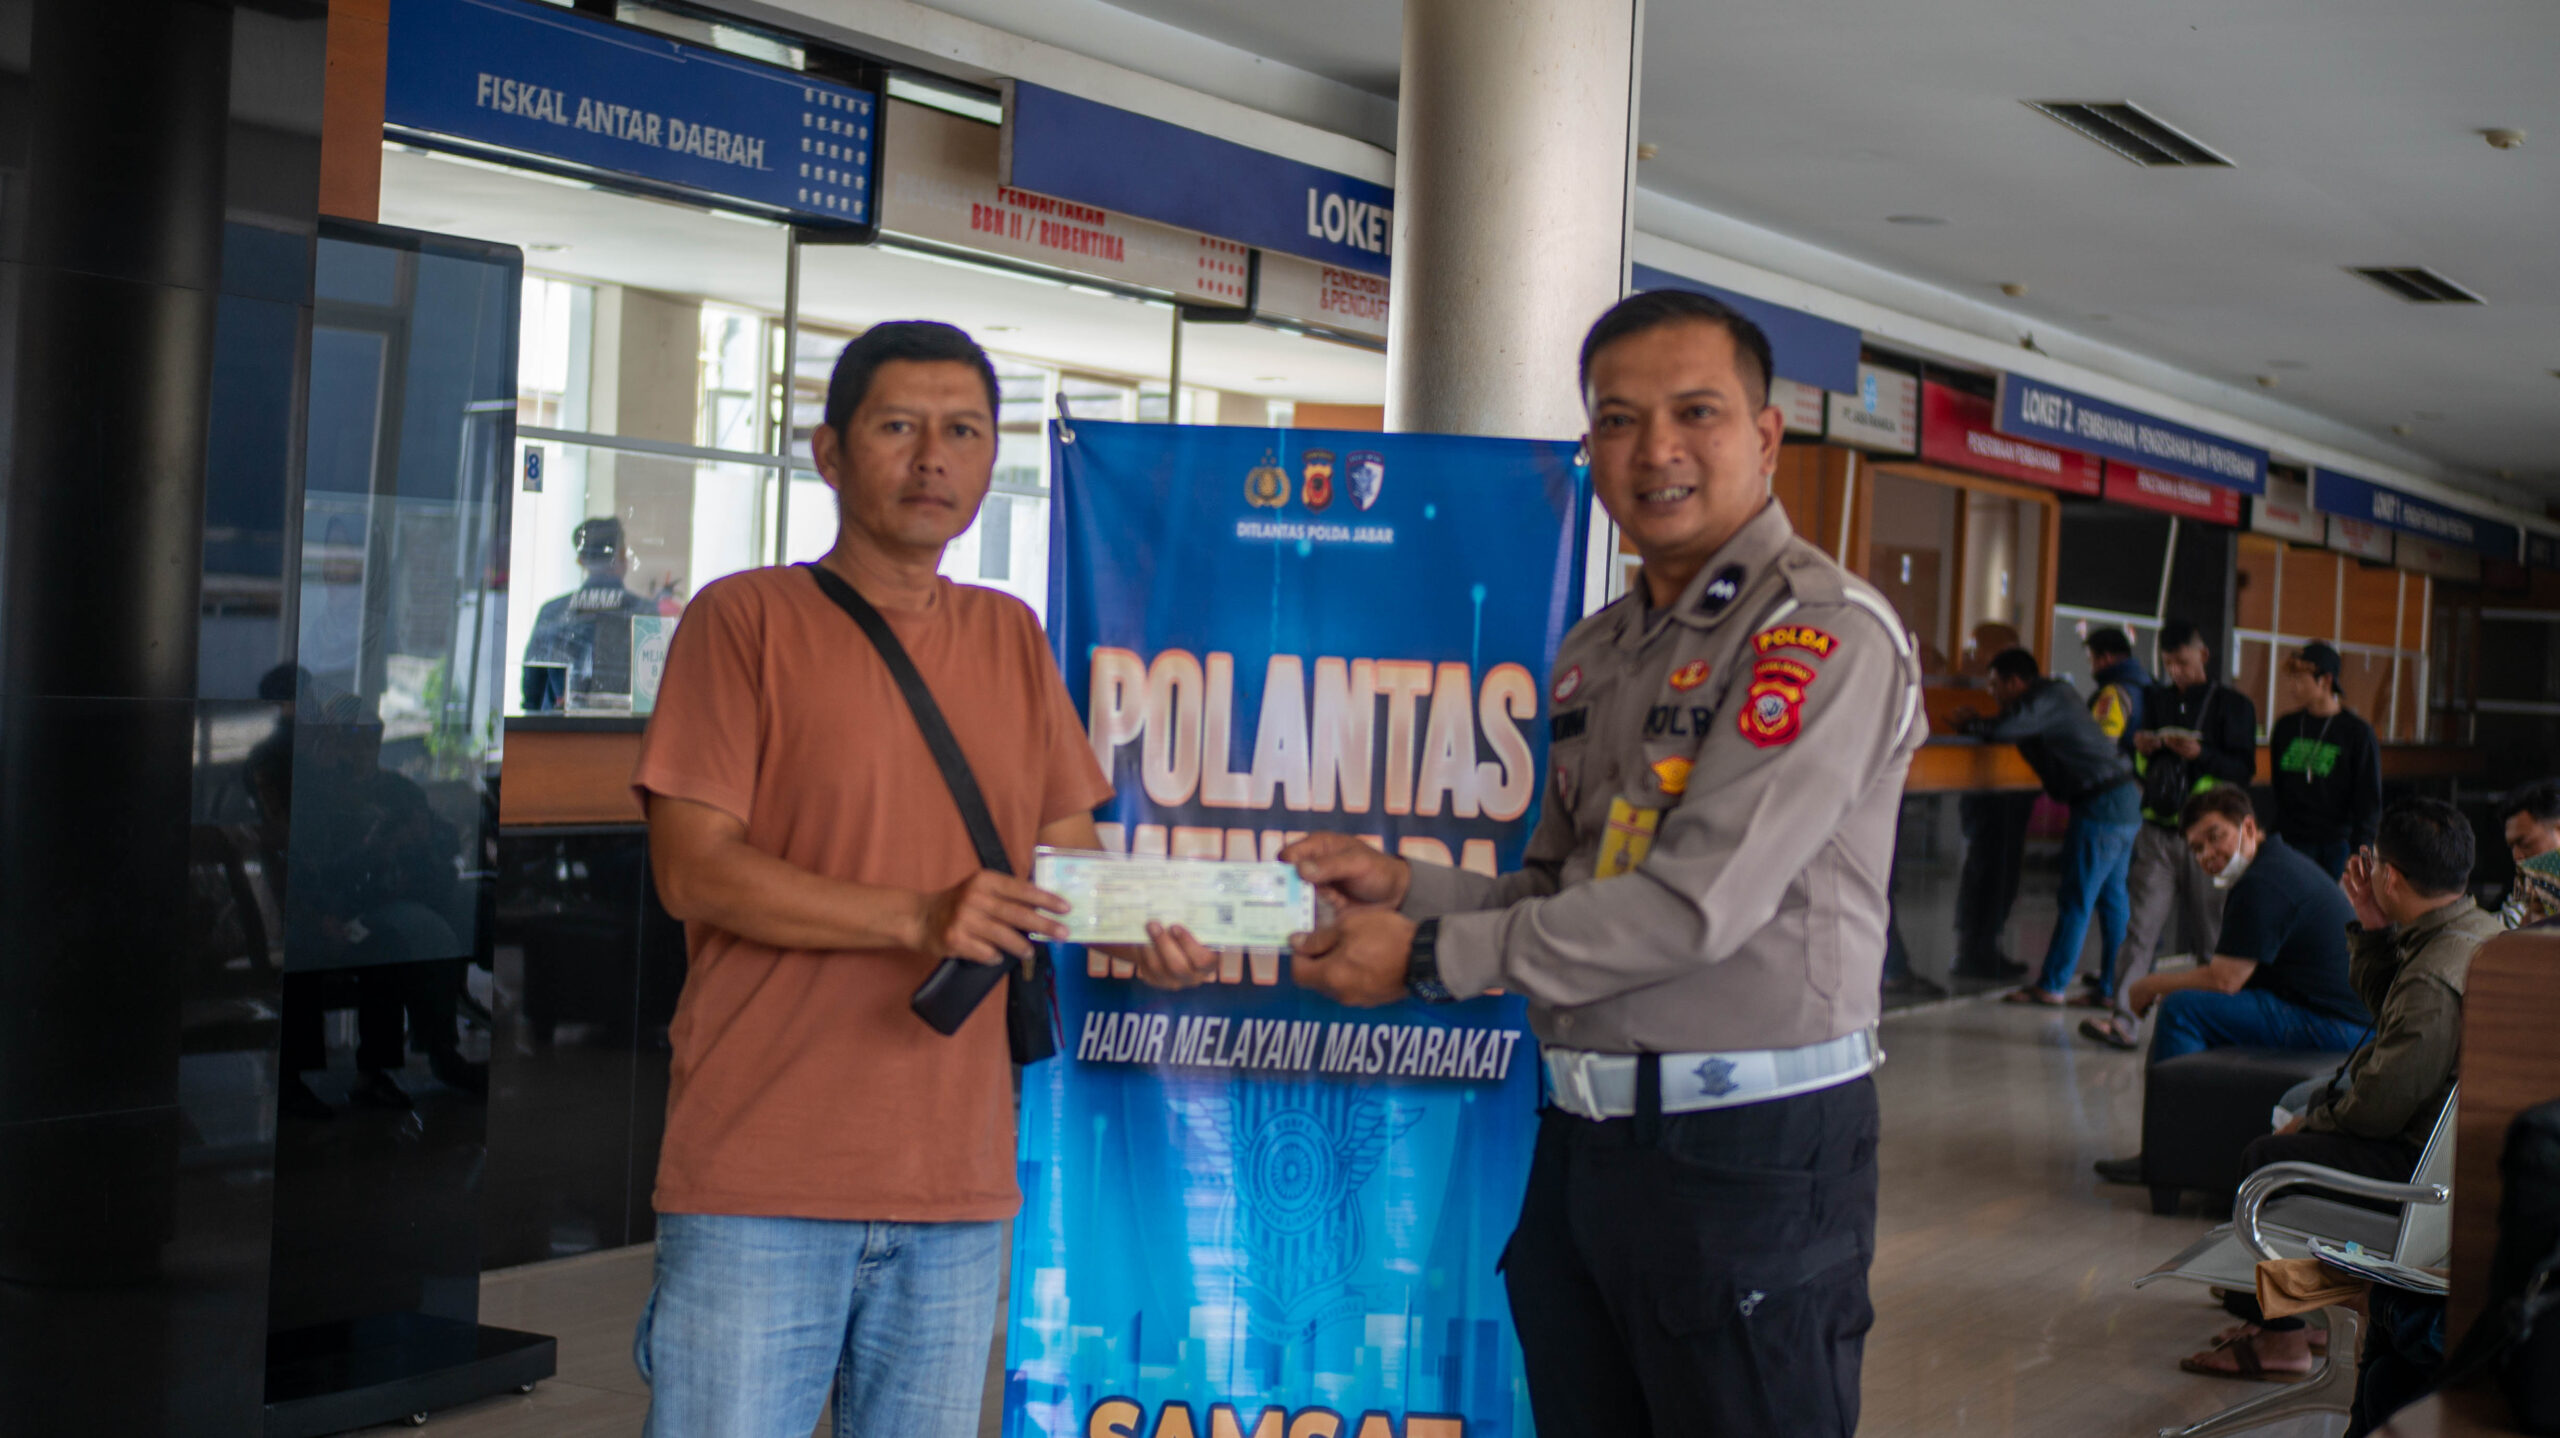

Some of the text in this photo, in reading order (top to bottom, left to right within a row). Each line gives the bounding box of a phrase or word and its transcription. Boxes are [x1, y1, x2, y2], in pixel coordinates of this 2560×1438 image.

[477, 73, 766, 169] FISKAL ANTAR DAERAH
[971, 203, 1004, 236] BBN
[1040, 220, 1124, 263] RUBENTINA
[2022, 386, 2064, 430] LOKET
[527, 454, 540, 479] 8
[1237, 522, 1394, 543] DITLANTAS POLDA JABAR
[1758, 626, 1830, 654] POLDA
[1089, 647, 1538, 822] POLANTAS
[1077, 1011, 1521, 1080] HADIR MELAYANI MASYARAKAT
